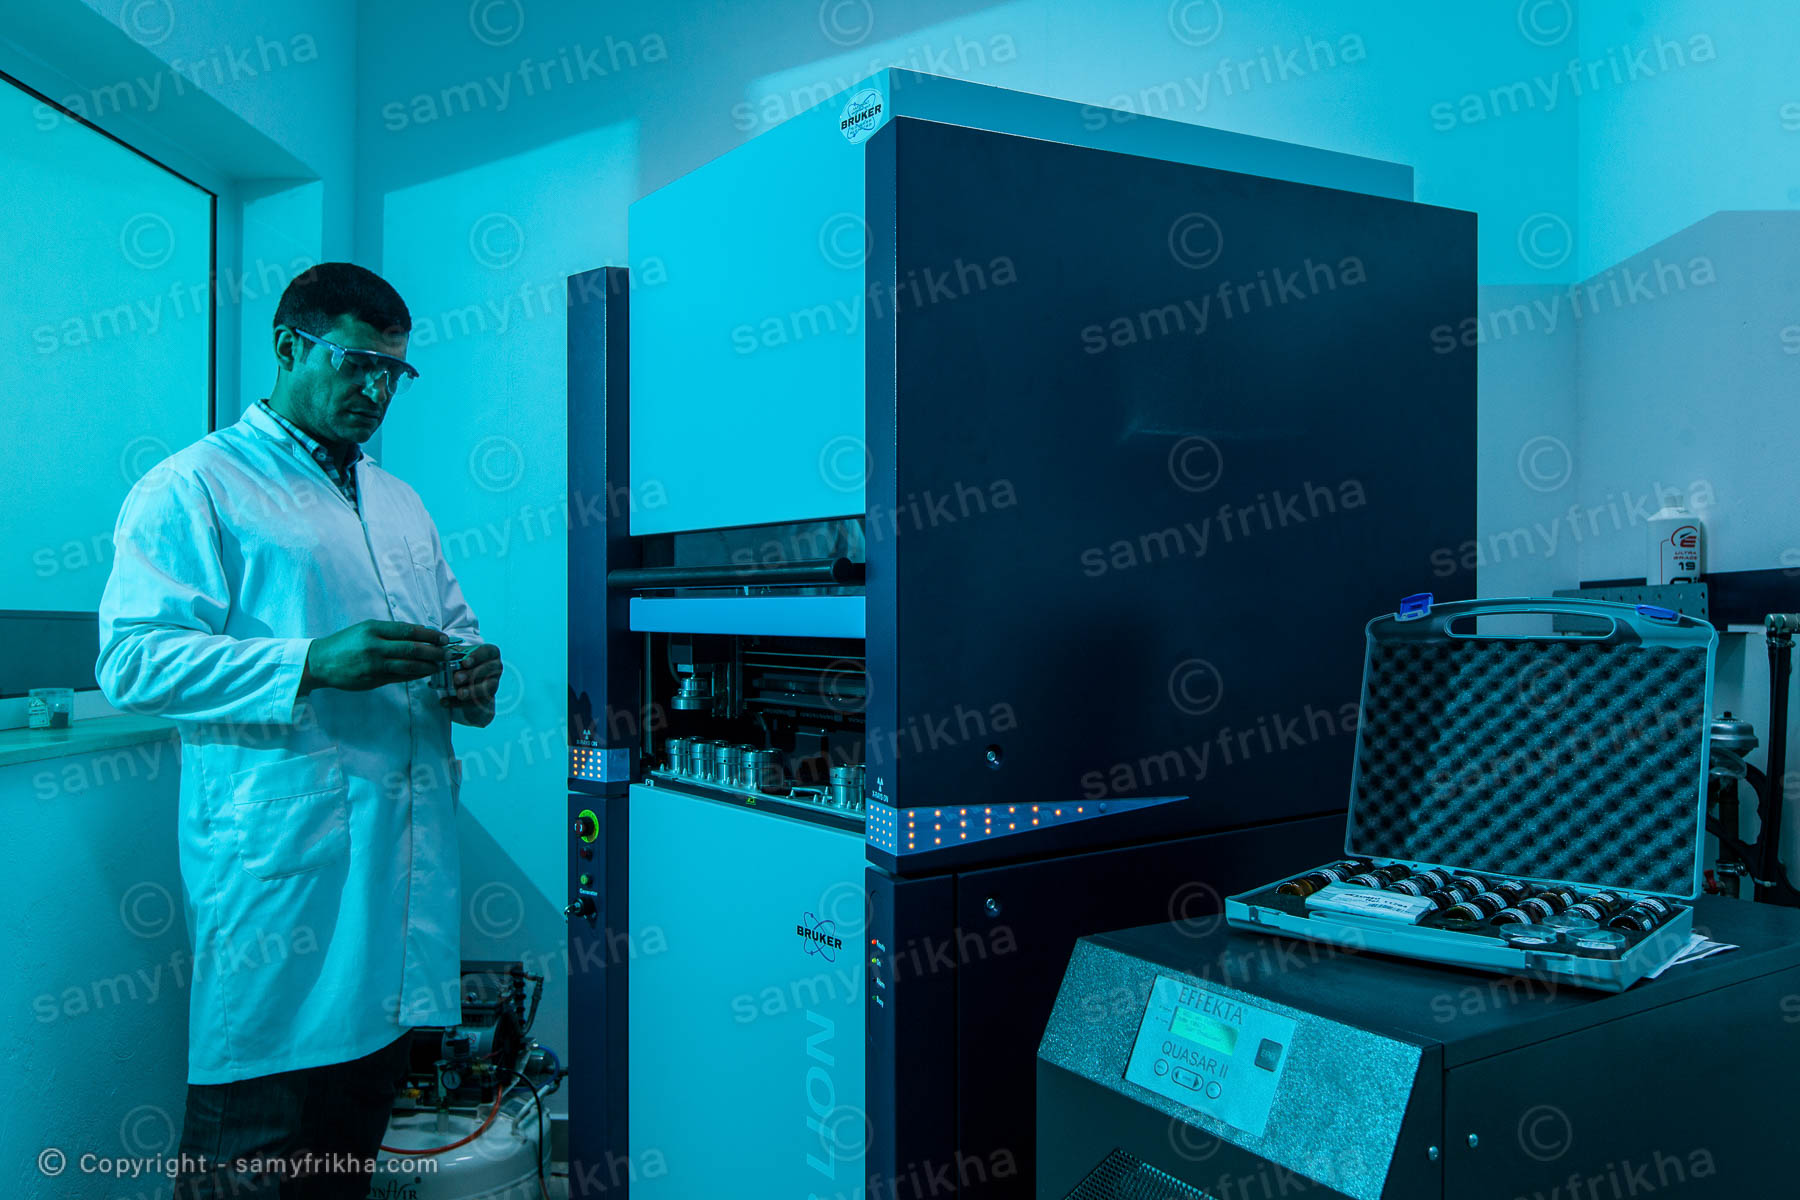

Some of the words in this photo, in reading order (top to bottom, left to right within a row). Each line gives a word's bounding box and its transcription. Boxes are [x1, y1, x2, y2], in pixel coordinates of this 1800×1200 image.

[841, 103, 882, 130] BRUKER
[1678, 561, 1696, 571] 19
[797, 925, 842, 950] BRUKER
[1178, 986, 1243, 1025] EFFEKTA
[1161, 1040, 1217, 1075] QUASAR
[1219, 1064, 1229, 1080] II
[806, 1009, 836, 1181] LION
